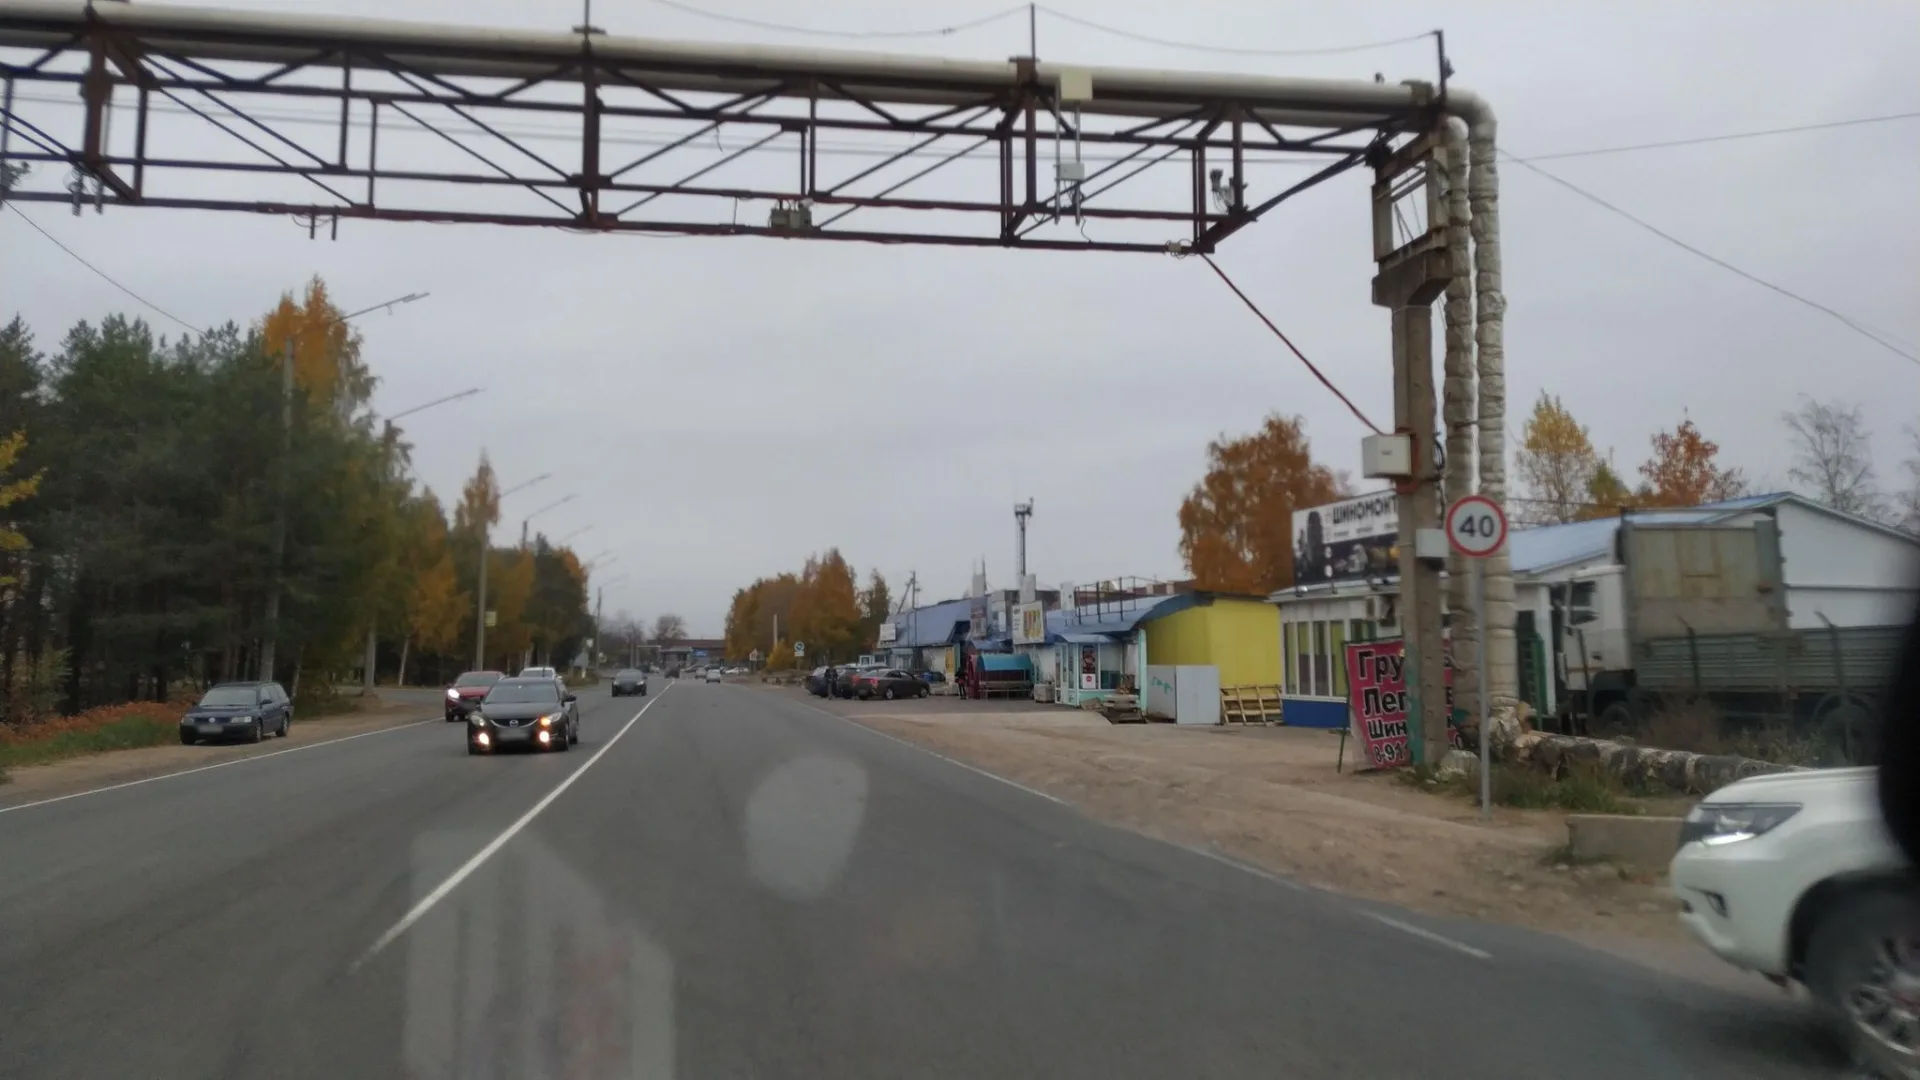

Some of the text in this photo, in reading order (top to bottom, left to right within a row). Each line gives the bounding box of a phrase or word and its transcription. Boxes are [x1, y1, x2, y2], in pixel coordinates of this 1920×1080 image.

[1332, 494, 1398, 525] ШИНОМОНТ
[1459, 514, 1494, 537] 40
[1357, 649, 1404, 685] Гру
[1363, 687, 1407, 717] Лег
[1366, 718, 1407, 741] Шин
